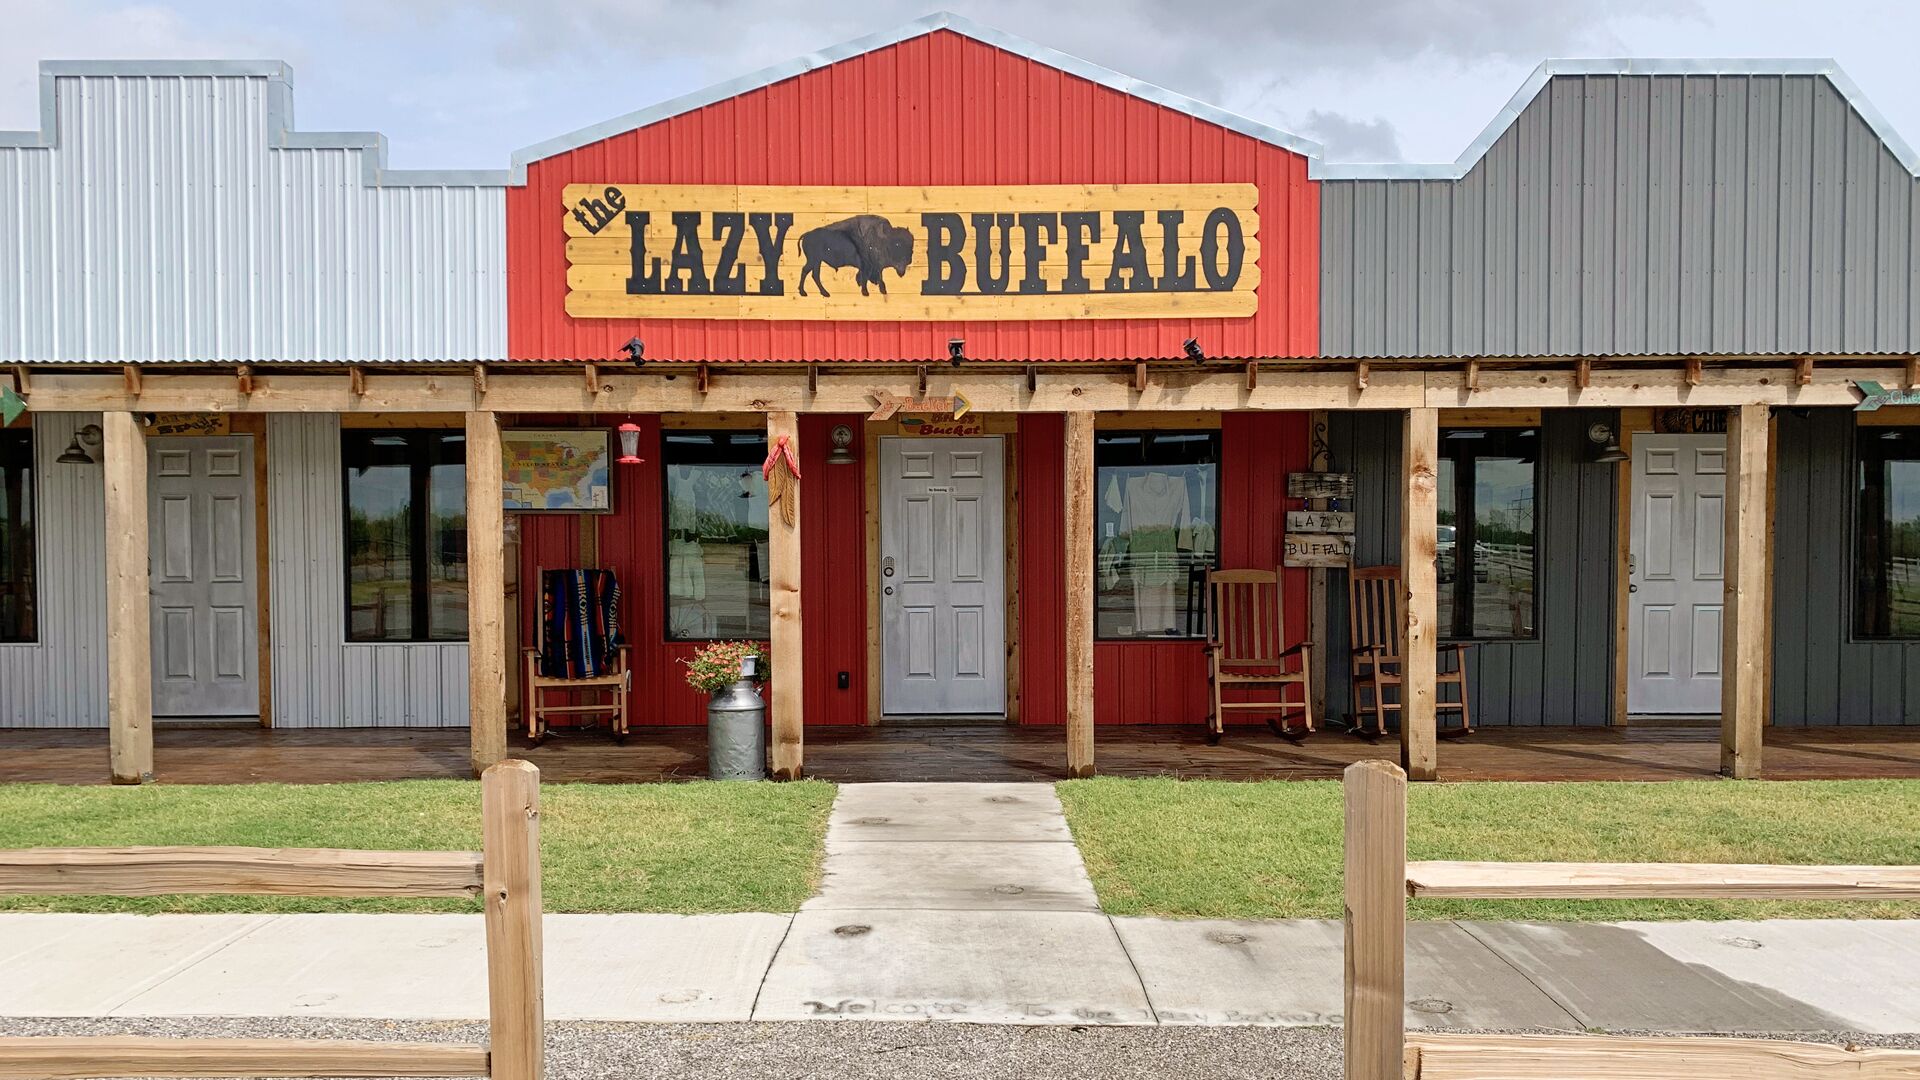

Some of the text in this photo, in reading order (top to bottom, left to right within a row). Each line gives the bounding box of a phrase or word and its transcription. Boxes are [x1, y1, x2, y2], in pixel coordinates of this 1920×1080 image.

[572, 186, 626, 235] the
[625, 207, 1245, 296] LAZY BUFFALO
[919, 424, 981, 436] Bucket
[1296, 514, 1343, 528] LAZY
[1288, 541, 1351, 556] BUFFALO
